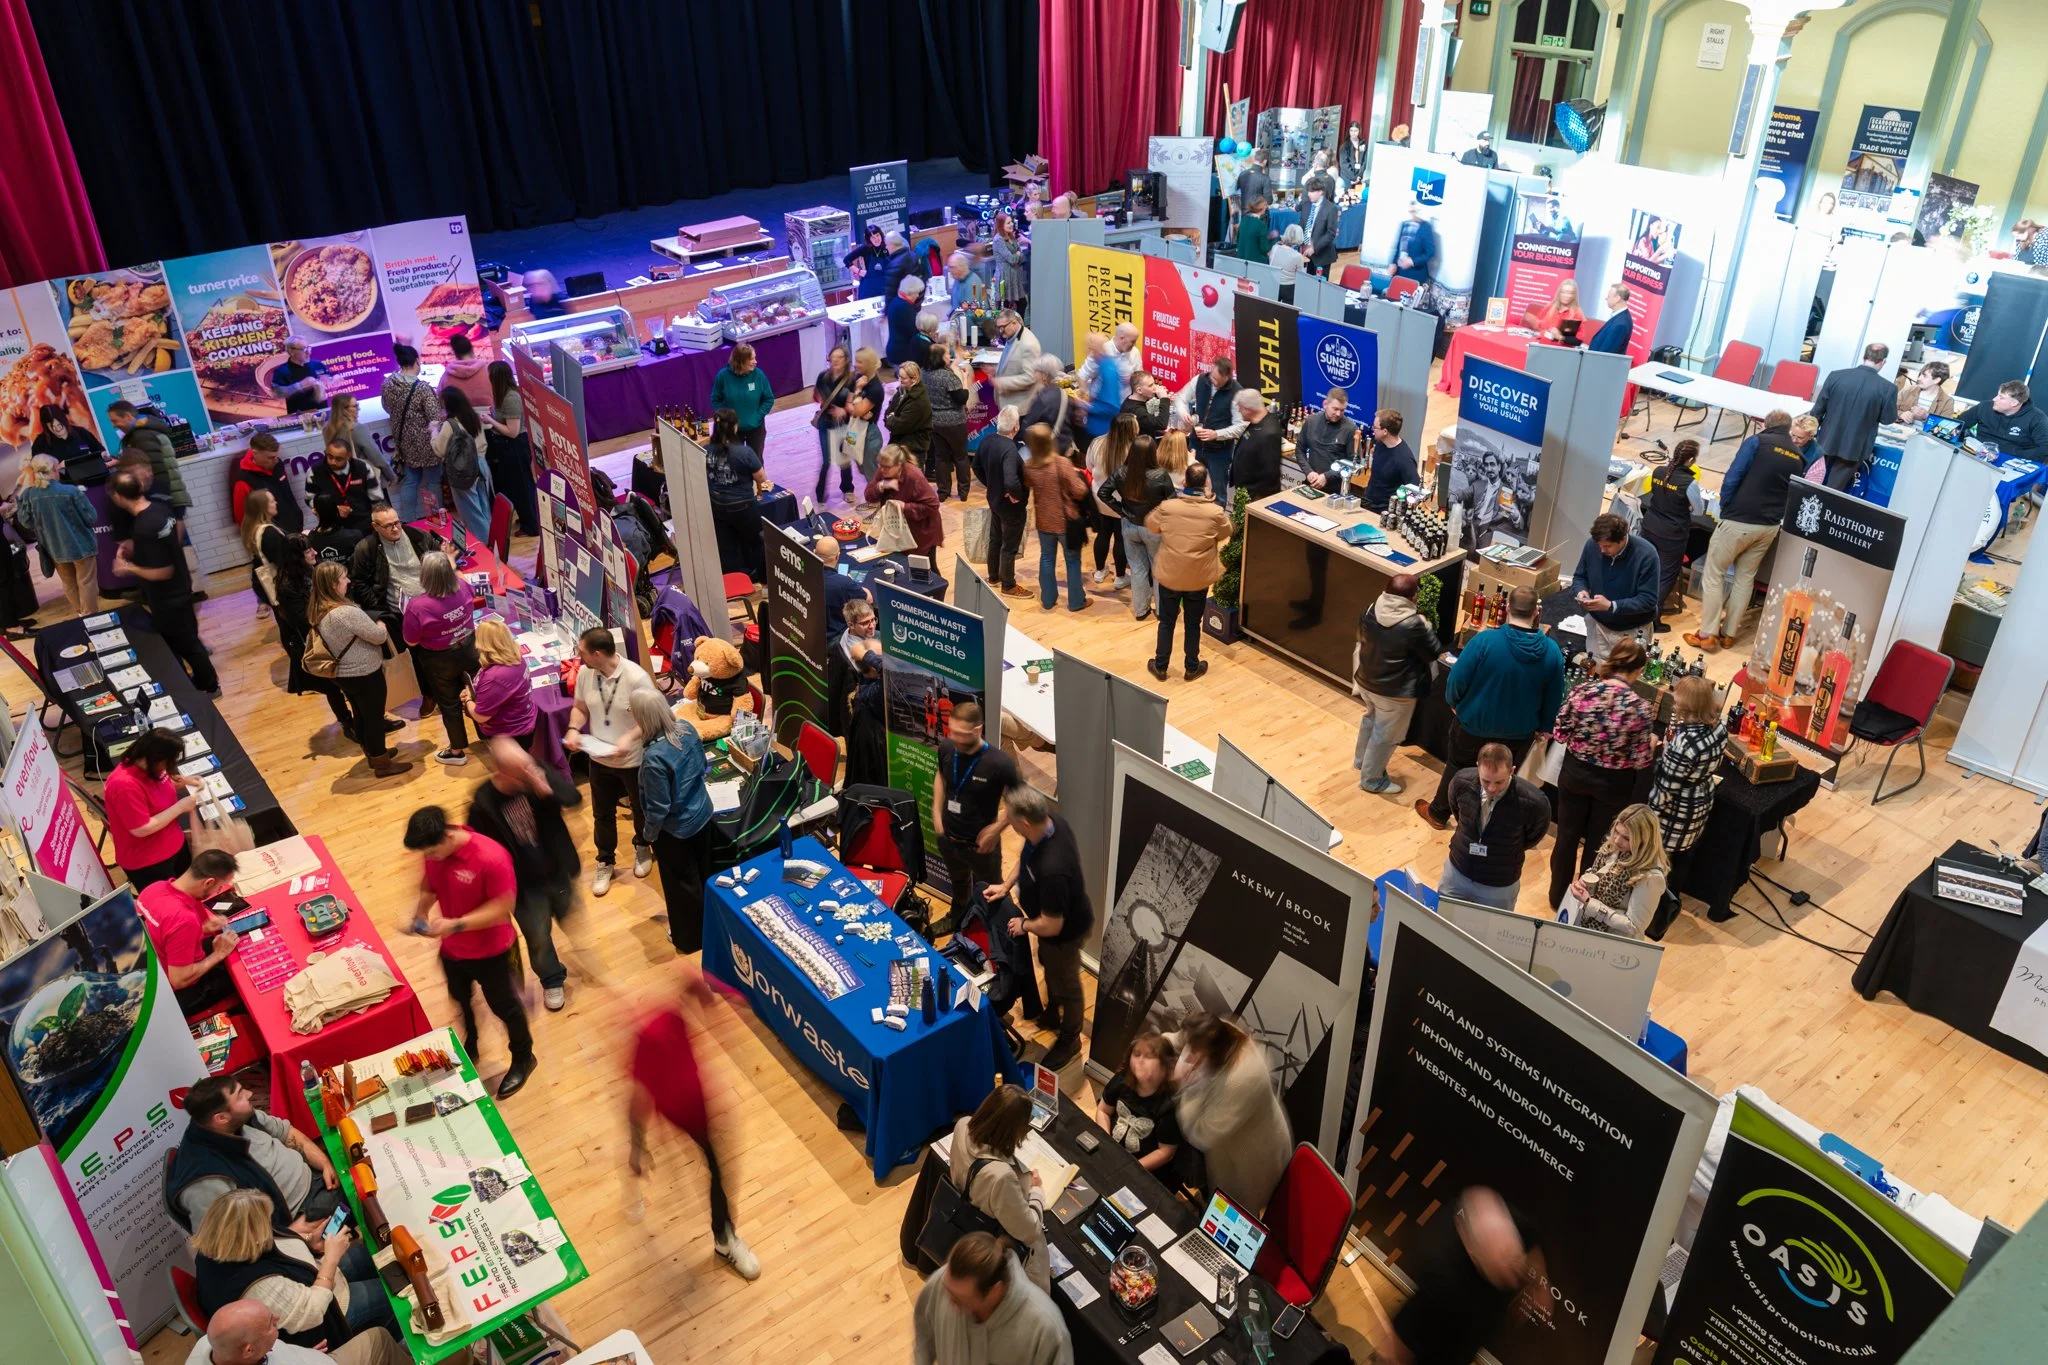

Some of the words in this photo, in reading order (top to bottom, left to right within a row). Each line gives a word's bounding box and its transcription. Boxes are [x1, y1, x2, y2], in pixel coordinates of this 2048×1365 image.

[1787, 130, 1804, 139] chat
[1871, 118, 1910, 128] SCARBOROUGH
[1860, 144, 1879, 152] TRADE
[1880, 146, 1897, 154] WITH
[864, 182, 896, 193] YORVALE
[857, 197, 906, 211] AWARD-WINNING
[450, 224, 462, 232] tp
[1514, 249, 1535, 260] YOUR
[1535, 254, 1575, 265] BUSINESS
[1517, 242, 1572, 256] CONNECTING
[385, 259, 412, 270] British
[387, 267, 411, 278] Fresh
[412, 261, 450, 274] produce.
[1625, 260, 1662, 280] SUPPORTING
[188, 280, 227, 295] turner
[228, 274, 259, 290] price
[388, 276, 410, 285] Daily
[412, 269, 450, 282] prepared
[390, 280, 439, 292] vegetables.
[1636, 274, 1664, 290] BUSINESS
[1100, 266, 1112, 338] BREWIN
[202, 320, 264, 340] KEEPING
[1152, 310, 1180, 328] FRUITAGE
[204, 328, 276, 352] KITCHENS
[1144, 336, 1187, 358] BELGIAN
[352, 350, 376, 359] food.
[356, 356, 390, 367] snacks.
[1150, 352, 1180, 368] FRUIT
[1320, 352, 1357, 372] SUNSET
[1152, 366, 1177, 382] BEER
[1327, 364, 1350, 379] WINES
[1468, 374, 1538, 412] DISCOVER
[1479, 393, 1499, 408] TASTE
[1500, 401, 1530, 418] BEYOND
[1479, 401, 1498, 416] YOUR
[1500, 408, 1522, 424] USUAL
[548, 426, 580, 461] ROTAS
[552, 445, 576, 470] CLOCK
[1824, 508, 1885, 542] RAISTHORPE
[1828, 526, 1873, 550] DISTILLERY
[774, 565, 796, 589] Never
[796, 581, 811, 603] Stop
[778, 585, 808, 620] Learning
[890, 600, 940, 622] COMMERCIAL
[940, 616, 967, 634] WASTE
[898, 613, 949, 640] MANAGEMENT
[950, 632, 960, 643] BY
[890, 646, 910, 657] CREATING
[916, 655, 934, 666] CLEANER
[934, 661, 954, 674] GREENER
[953, 670, 970, 681] FUTURE
[896, 748, 916, 760] REDUCE
[916, 755, 926, 764] THE
[898, 741, 920, 754] HELPING
[920, 748, 936, 762] LOCAL
[902, 758, 914, 767] NOW
[16, 736, 38, 798] everflow
[1232, 870, 1275, 899] ASKEW
[1286, 899, 1331, 932] BROOK
[1292, 925, 1306, 935] make
[1292, 933, 1302, 941] web
[1426, 992, 1455, 1022] DATA
[1456, 1016, 1484, 1040] AND
[1486, 1036, 1540, 1082] SYSTEMS
[1542, 1076, 1633, 1150] INTEGRATION
[1421, 1022, 1464, 1062] IPHONE
[1464, 1058, 1492, 1082] AND
[1493, 1079, 1552, 1127] ANDROID
[1552, 1124, 1586, 1152] APPS
[1416, 1051, 1468, 1098] WEBSITES
[1468, 1094, 1496, 1119] AND
[1498, 1116, 1574, 1182] ECOMMERCE
[78, 1174, 98, 1192] AND
[98, 1118, 173, 1174] ENVIRONMENTAL
[110, 1138, 156, 1176] SERVICES
[156, 1122, 176, 1139] LTD
[92, 1212, 110, 1230] SAP
[108, 1216, 126, 1232] Fire
[128, 1200, 146, 1217] Risk
[114, 1224, 132, 1242] Fire
[134, 1210, 154, 1226] Door
[140, 1218, 157, 1234] PAT
[473, 1207, 485, 1222] LTD
[134, 1220, 172, 1253] Asbestos
[465, 1212, 496, 1267] ENVIRONMENTAL
[483, 1222, 500, 1256] SERVICES
[114, 1243, 160, 1284] Legionella
[160, 1228, 178, 1246] Risk
[490, 1268, 501, 1282] AND
[500, 1256, 520, 1294] PROPERTY
[1742, 1223, 1868, 1326] OASIS
[1528, 1267, 1588, 1326] BROOK
[1730, 1240, 1877, 1356] www.oasispromotions.co.uk
[1534, 1309, 1546, 1322] web
[1710, 1316, 1738, 1342] Fitting
[1739, 1338, 1754, 1354] out
[1732, 1304, 1767, 1336] Looking
[1769, 1333, 1784, 1347] for
[1784, 1346, 1808, 1365] your
[1738, 1318, 1766, 1346] Promo
[1690, 1336, 1719, 1362] Oasis
[1705, 1329, 1729, 1350] Need
[1730, 1348, 1748, 1365] new
